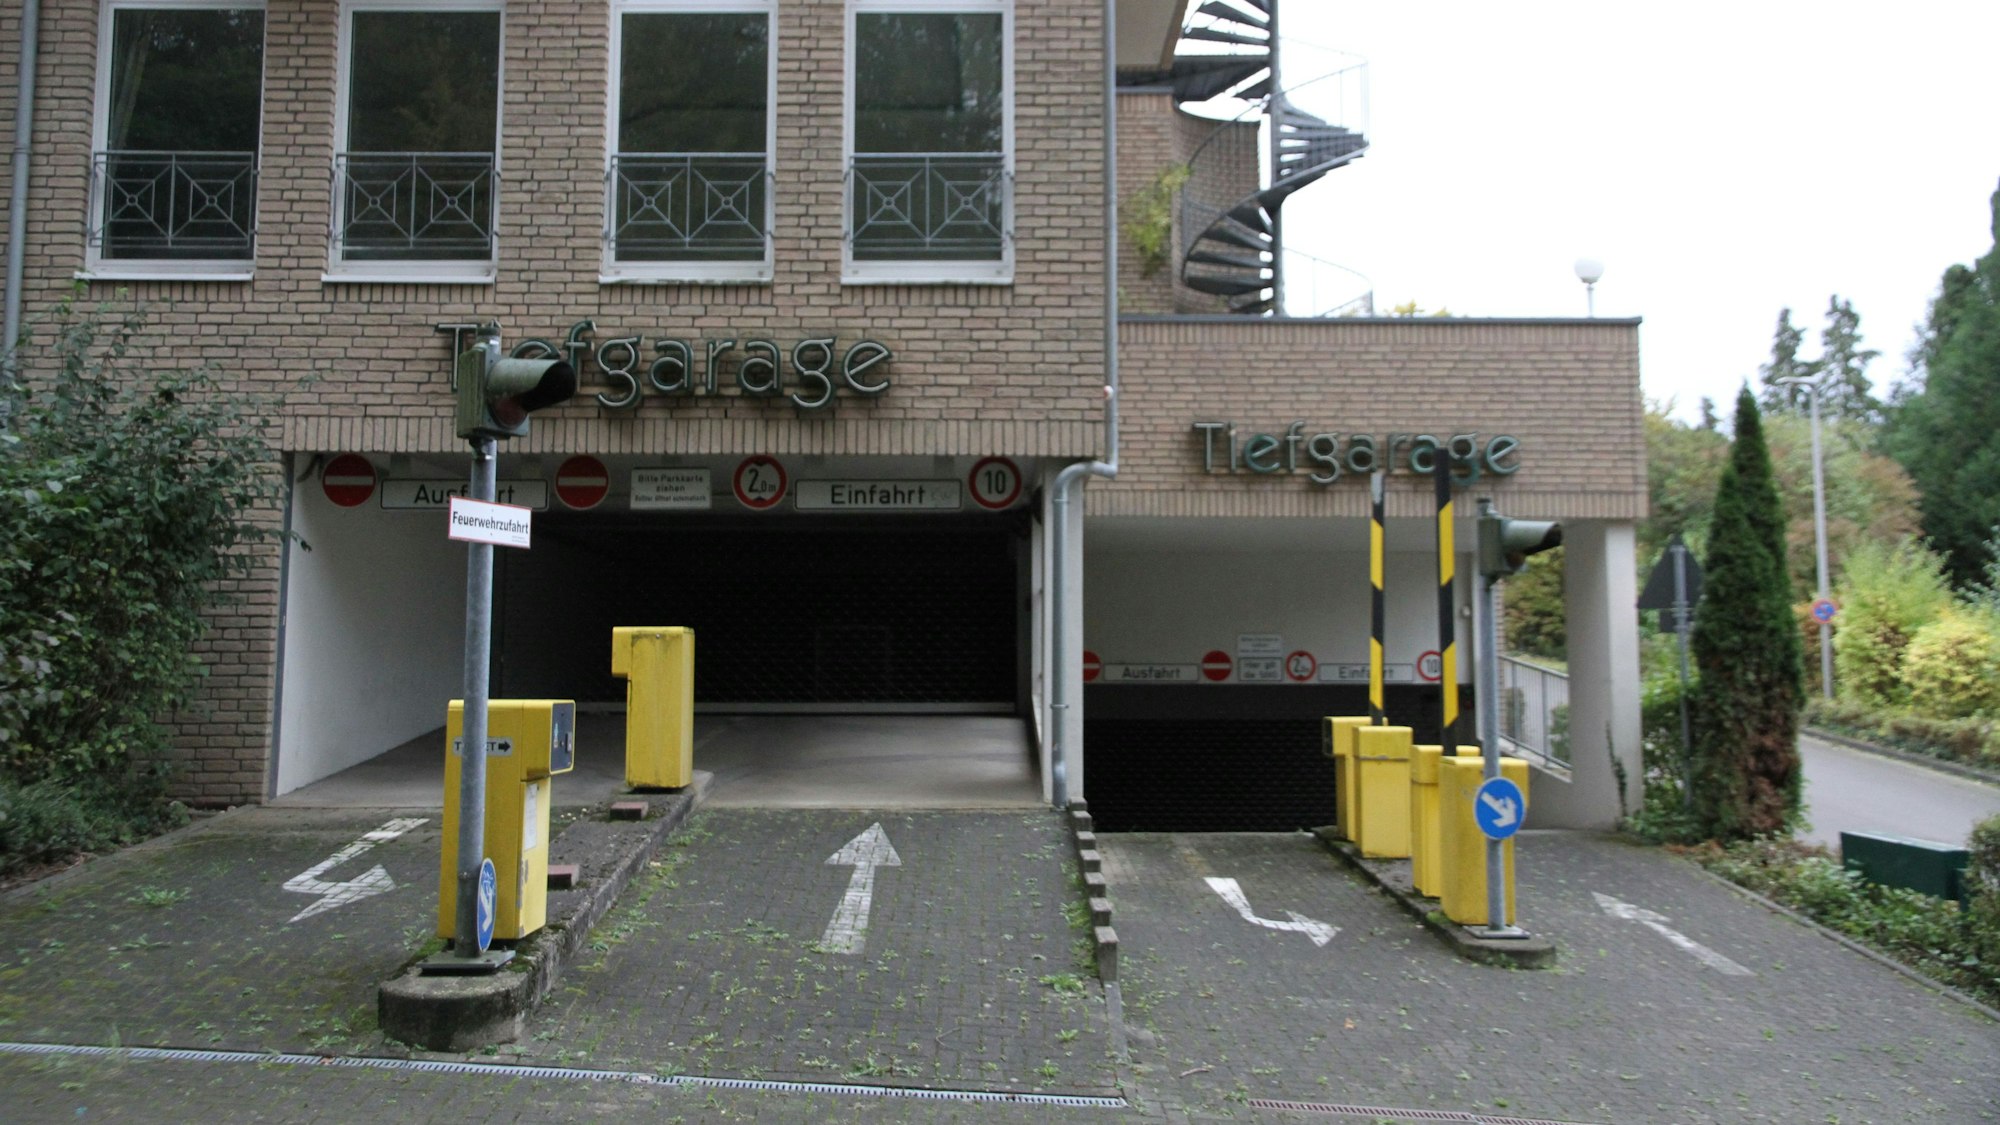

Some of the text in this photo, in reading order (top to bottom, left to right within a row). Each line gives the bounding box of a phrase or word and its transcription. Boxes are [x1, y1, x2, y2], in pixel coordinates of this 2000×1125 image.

[434, 319, 893, 410] Tfgarage
[1192, 419, 1520, 485] Tiefgarage
[414, 483, 514, 504] Ausfrt
[984, 470, 1006, 494] 10
[831, 485, 925, 505] Einfahrt
[452, 511, 529, 534] Feuerwehrzufahrt
[1122, 666, 1180, 678] Ausfahrt
